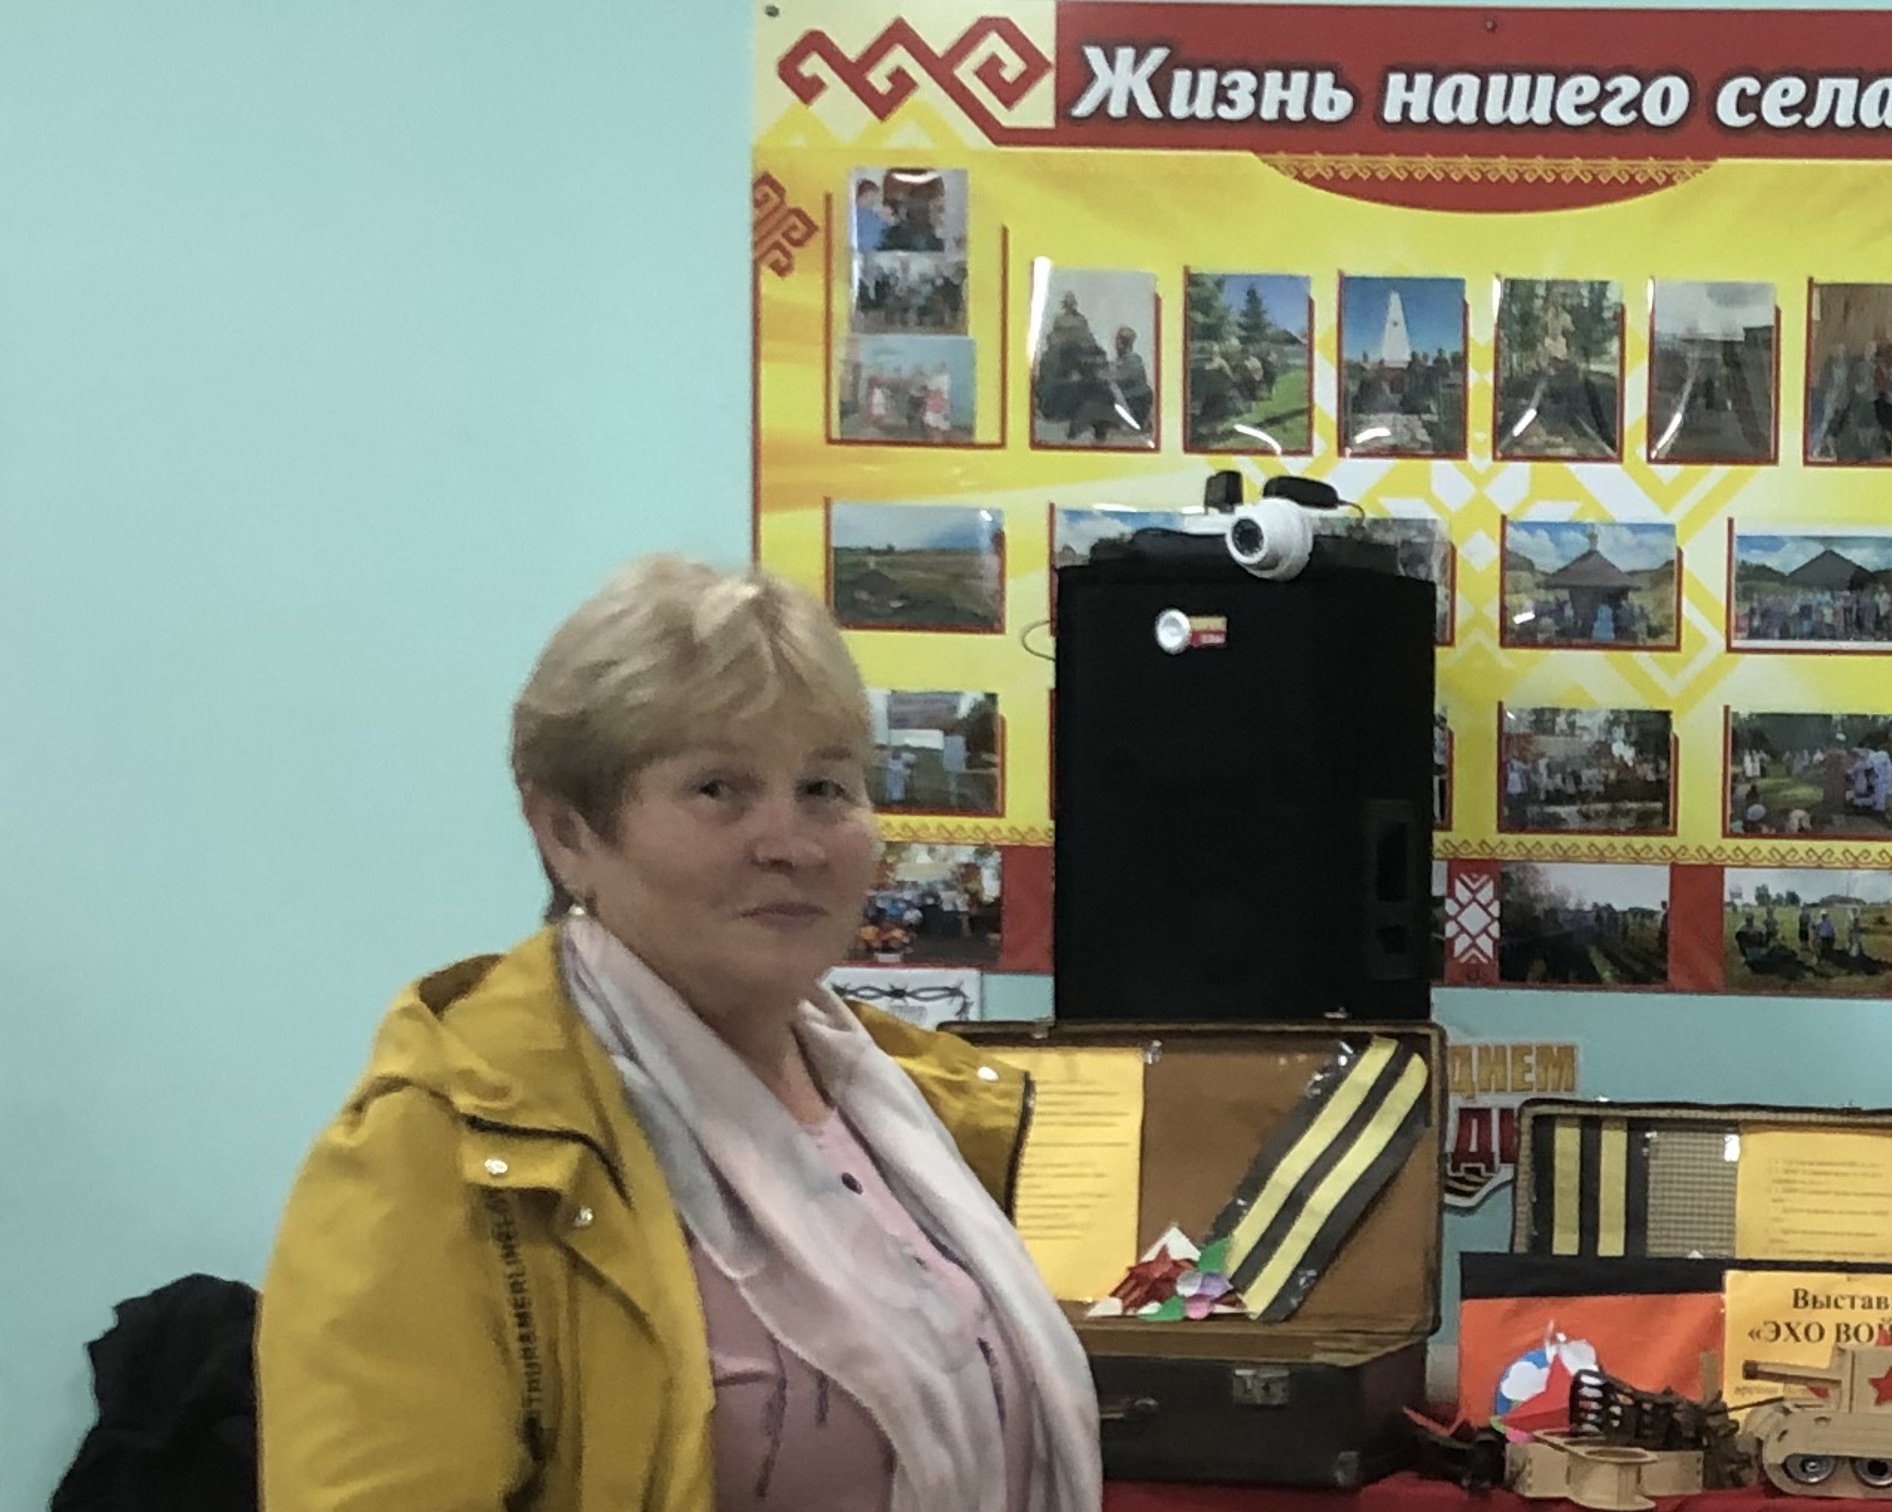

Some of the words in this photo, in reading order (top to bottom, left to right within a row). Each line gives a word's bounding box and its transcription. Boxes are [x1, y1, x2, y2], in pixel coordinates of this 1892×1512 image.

[1070, 45, 1355, 122] Жизнь
[1382, 69, 1692, 127] нашего
[1446, 1043, 1577, 1100] ДНЕМ
[1747, 1319, 1826, 1344] «ЭХО
